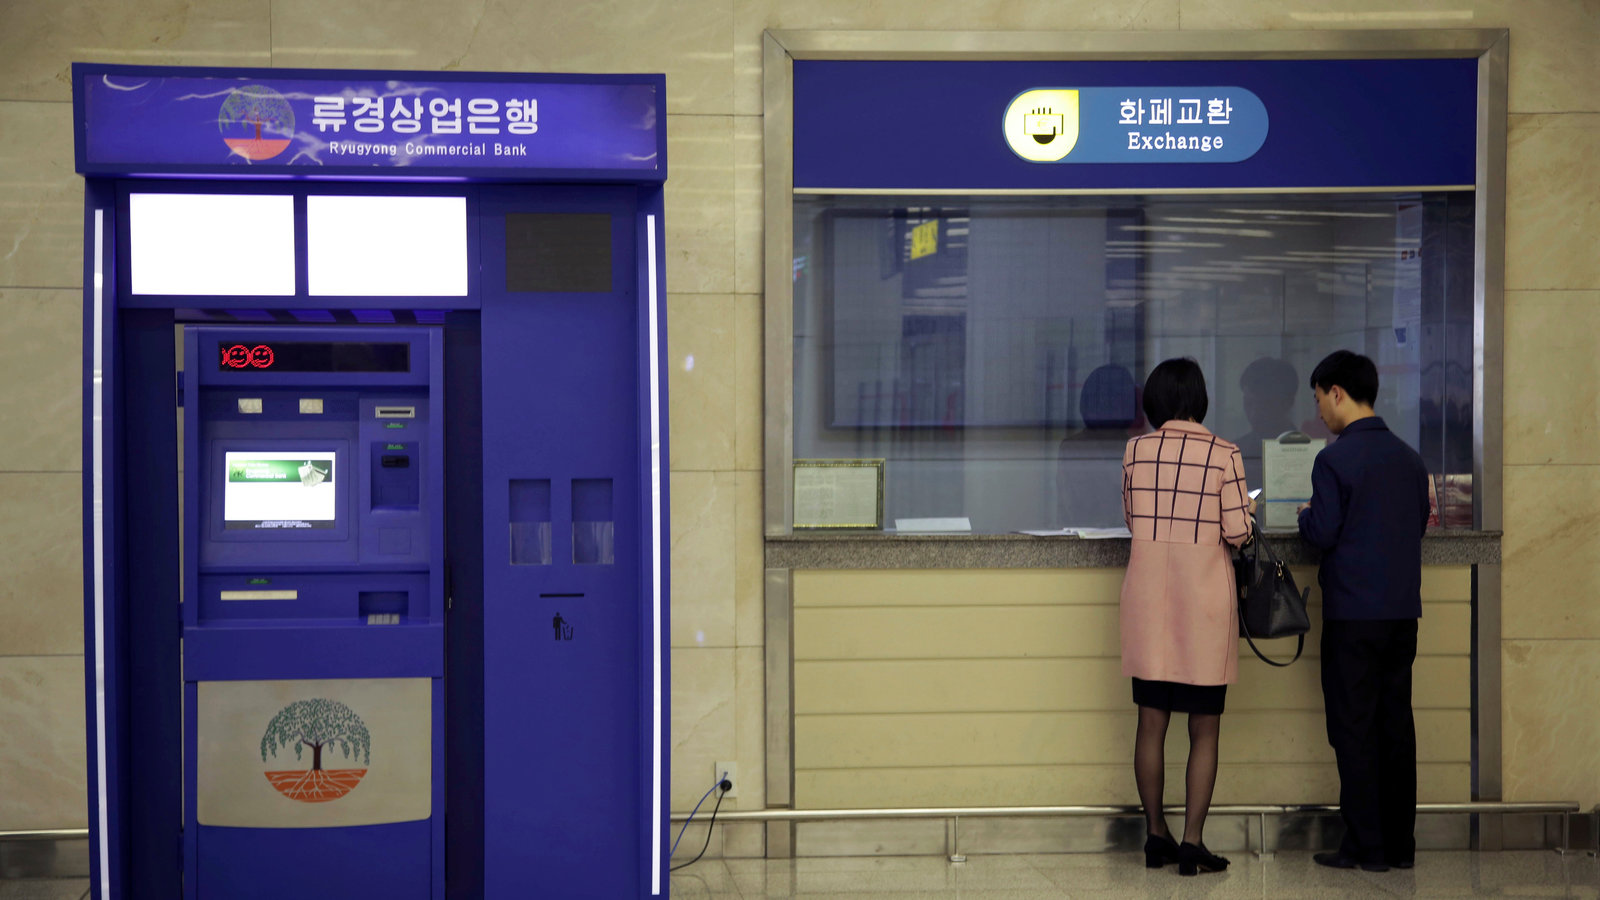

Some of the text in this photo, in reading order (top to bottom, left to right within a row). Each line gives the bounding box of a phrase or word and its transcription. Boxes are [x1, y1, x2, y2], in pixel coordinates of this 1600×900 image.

[312, 96, 538, 135] 류경상업은행
[1118, 97, 1233, 126] 화페교환
[329, 140, 527, 157] Ryugyong Commercial Bank
[1127, 131, 1224, 152] Exchange
